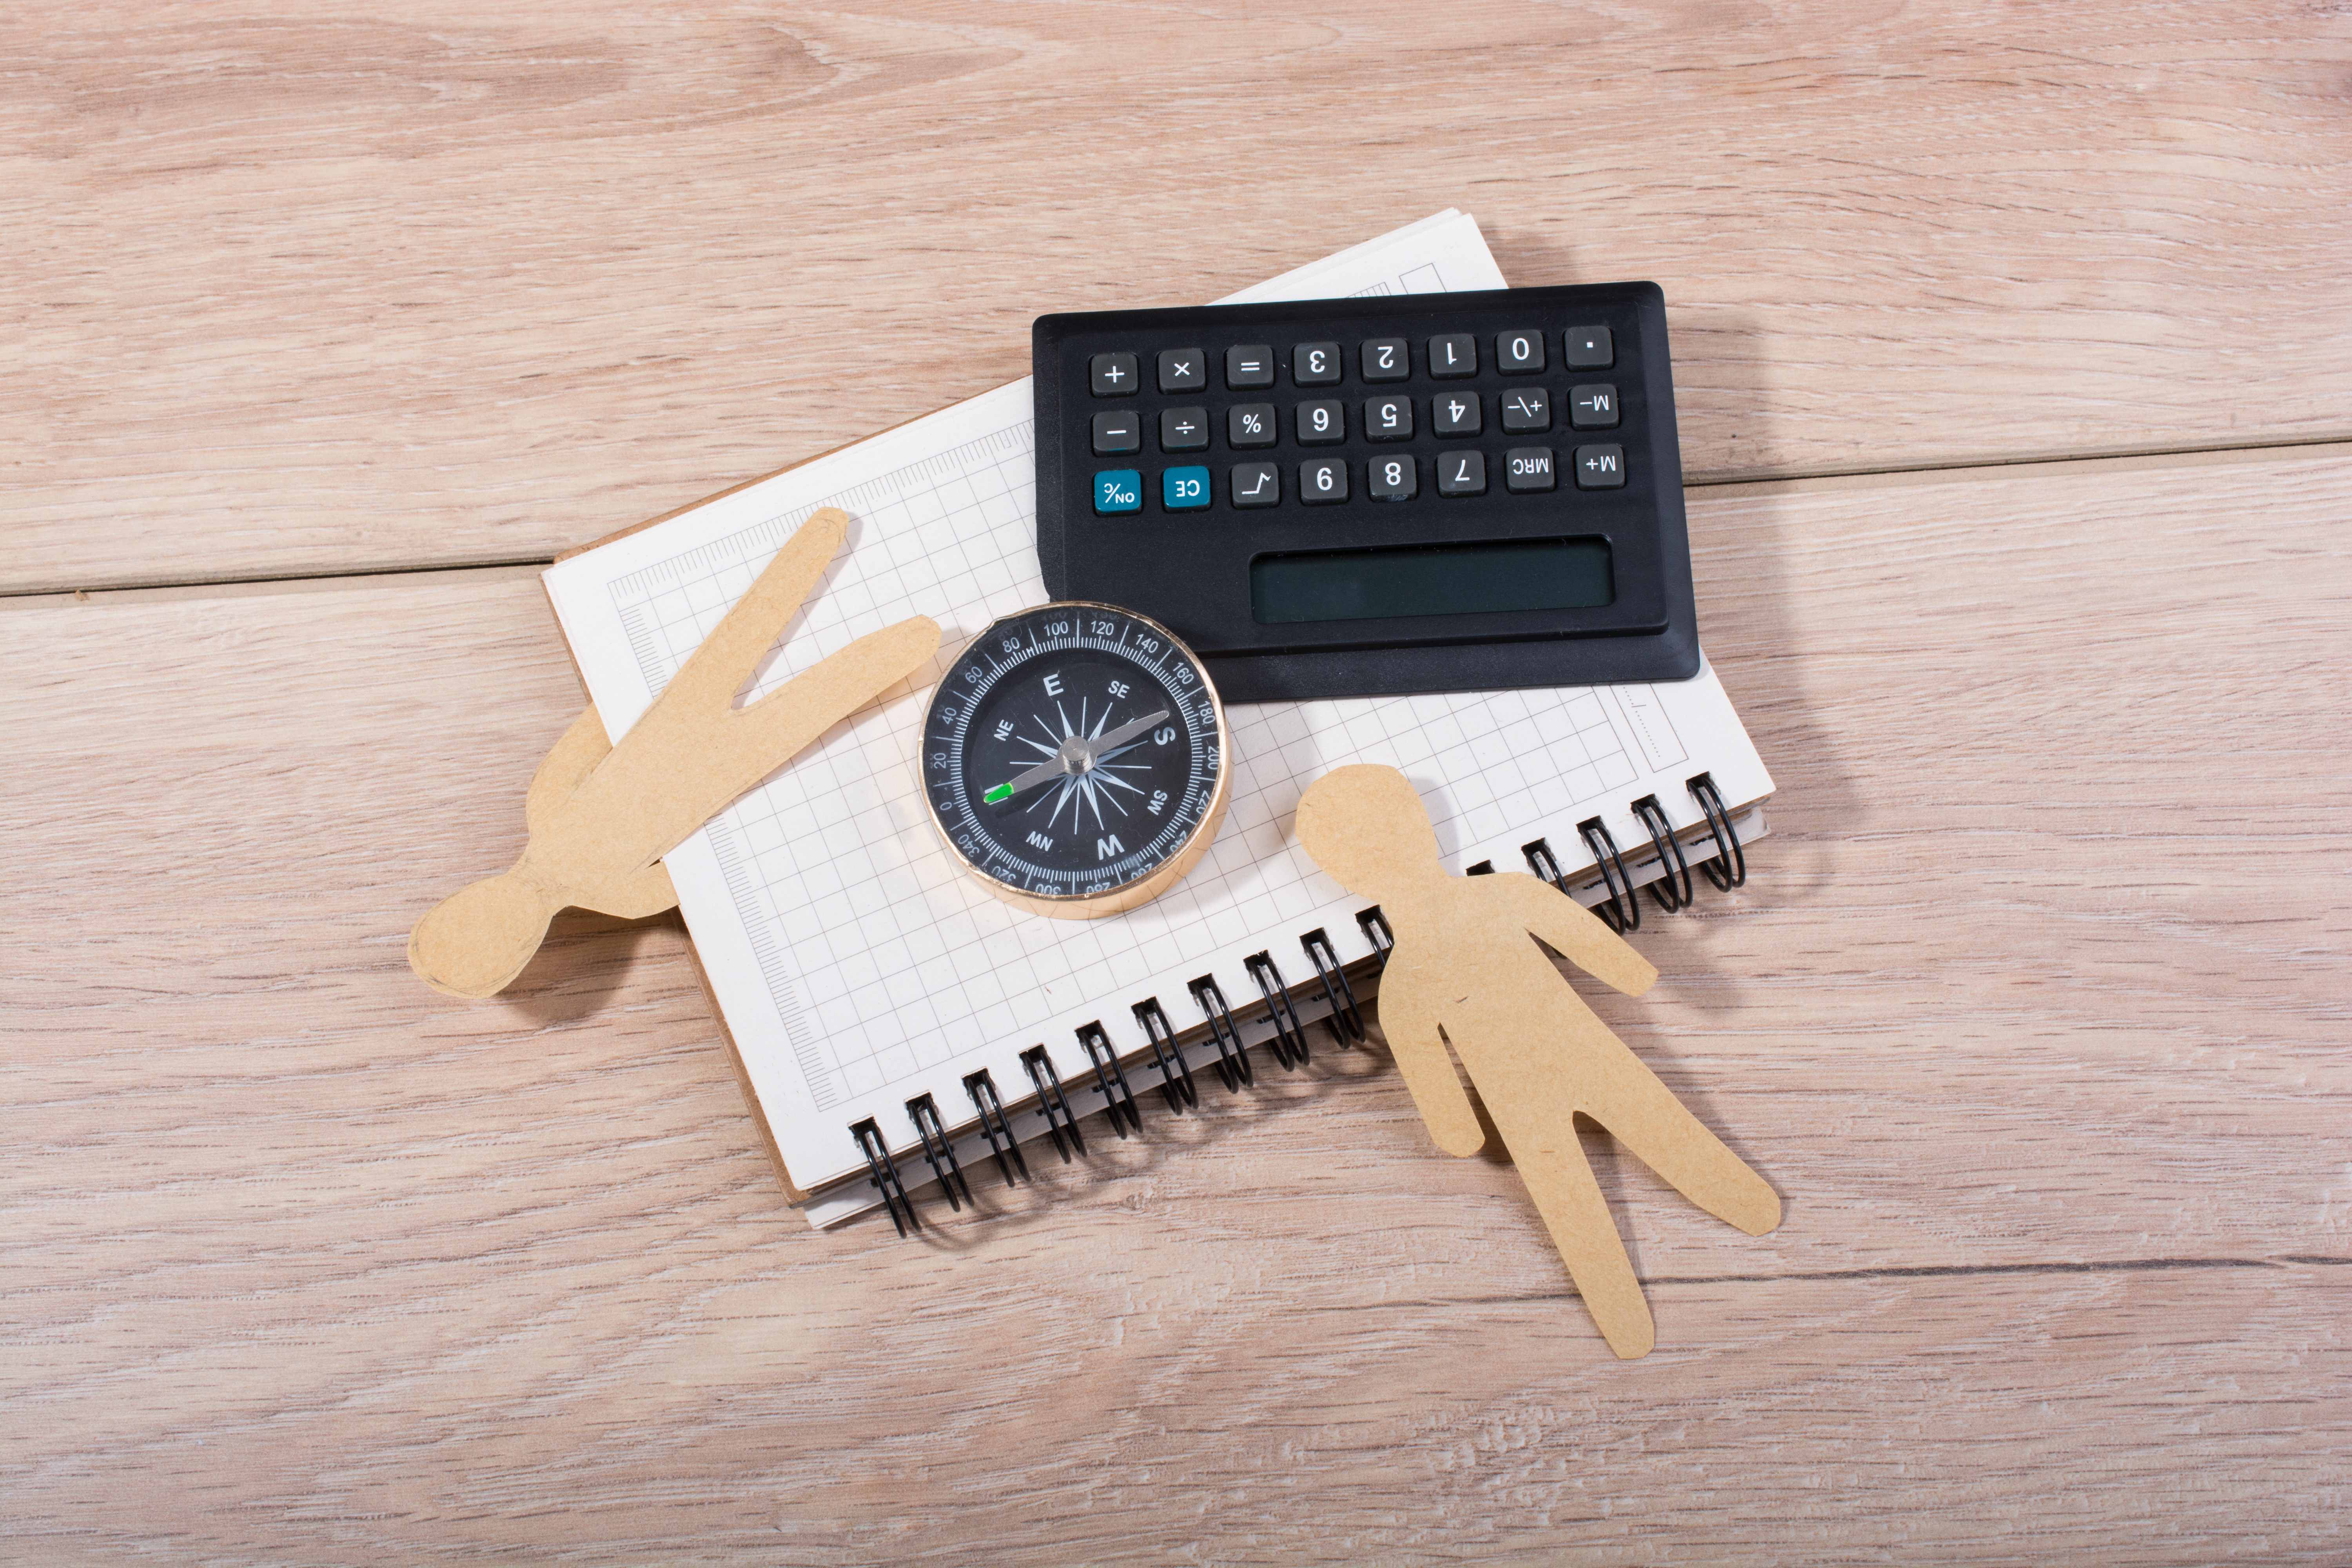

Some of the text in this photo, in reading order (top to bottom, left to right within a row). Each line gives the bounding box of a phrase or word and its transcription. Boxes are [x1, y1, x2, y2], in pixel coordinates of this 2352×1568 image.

[1377, 346, 1394, 368] 2
[1447, 342, 1457, 365] 1
[1512, 338, 1530, 360] 0
[1309, 350, 1325, 373] 3
[1313, 408, 1329, 431] 6
[1381, 404, 1397, 427] 5
[1448, 400, 1466, 423] 4
[1243, 414, 1261, 434] %
[1385, 462, 1401, 486] 8
[1455, 459, 1470, 481] 7
[1512, 458, 1549, 475] MRC
[1586, 456, 1616, 472] M+
[1176, 480, 1200, 497] CE
[1317, 467, 1333, 491] 9
[1043, 621, 1069, 635] 100
[1091, 621, 1114, 635] 120
[1002, 637, 1020, 653] 80
[1135, 633, 1158, 653] 140
[965, 666, 983, 683] 60
[1172, 662, 1194, 684] 160
[1043, 673, 1063, 696] E
[1108, 681, 1130, 699] SE
[942, 707, 957, 724] 40
[1198, 701, 1215, 724] 180
[994, 720, 1014, 741] NE
[1154, 727, 1176, 746] S
[934, 753, 946, 769] 20
[1208, 746, 1220, 769] 200
[940, 802, 952, 811] 0
[1147, 790, 1167, 815] SW
[958, 834, 980, 857] 340
[1025, 831, 1053, 851] NW
[1097, 834, 1124, 860] W
[991, 865, 1016, 881] 320
[1036, 884, 1062, 895] 300
